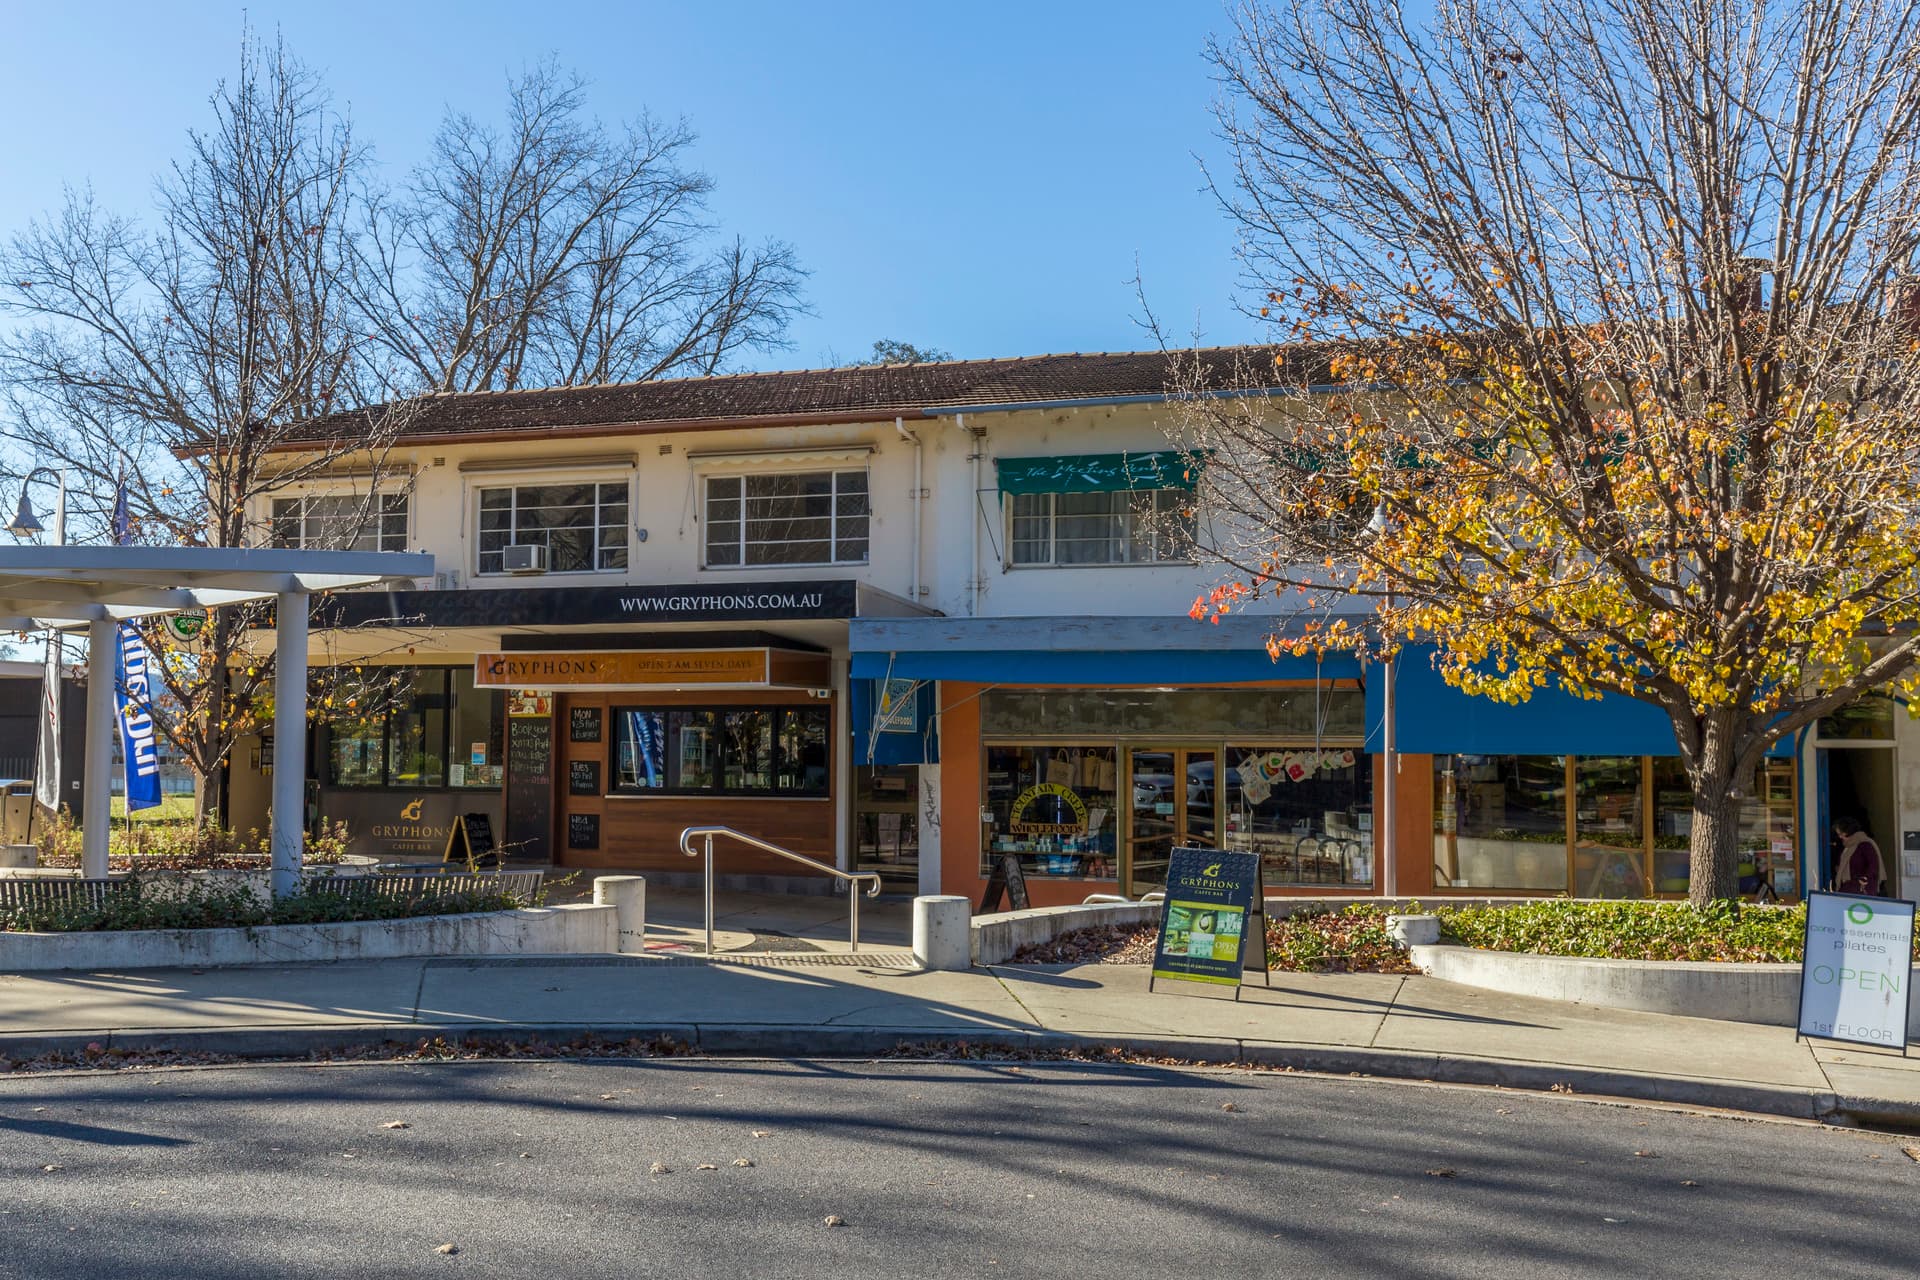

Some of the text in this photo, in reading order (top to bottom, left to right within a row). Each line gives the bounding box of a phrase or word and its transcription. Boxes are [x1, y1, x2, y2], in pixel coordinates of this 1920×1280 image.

[620, 594, 822, 612] WWW.GRYPHONS.COM.AU
[489, 658, 597, 675] GRYPHONS
[880, 716, 912, 726] WLEFOODS
[1011, 783, 1086, 822] MOUNTAIN CREEK
[1011, 823, 1083, 834] WHOLEFOODS
[1181, 878, 1240, 890] GRYPHONS
[1809, 924, 1909, 943] core essentials
[1833, 940, 1887, 954] pilates
[1813, 965, 1900, 994] OPEN
[1812, 1021, 1893, 1041] 1st FLOOR
